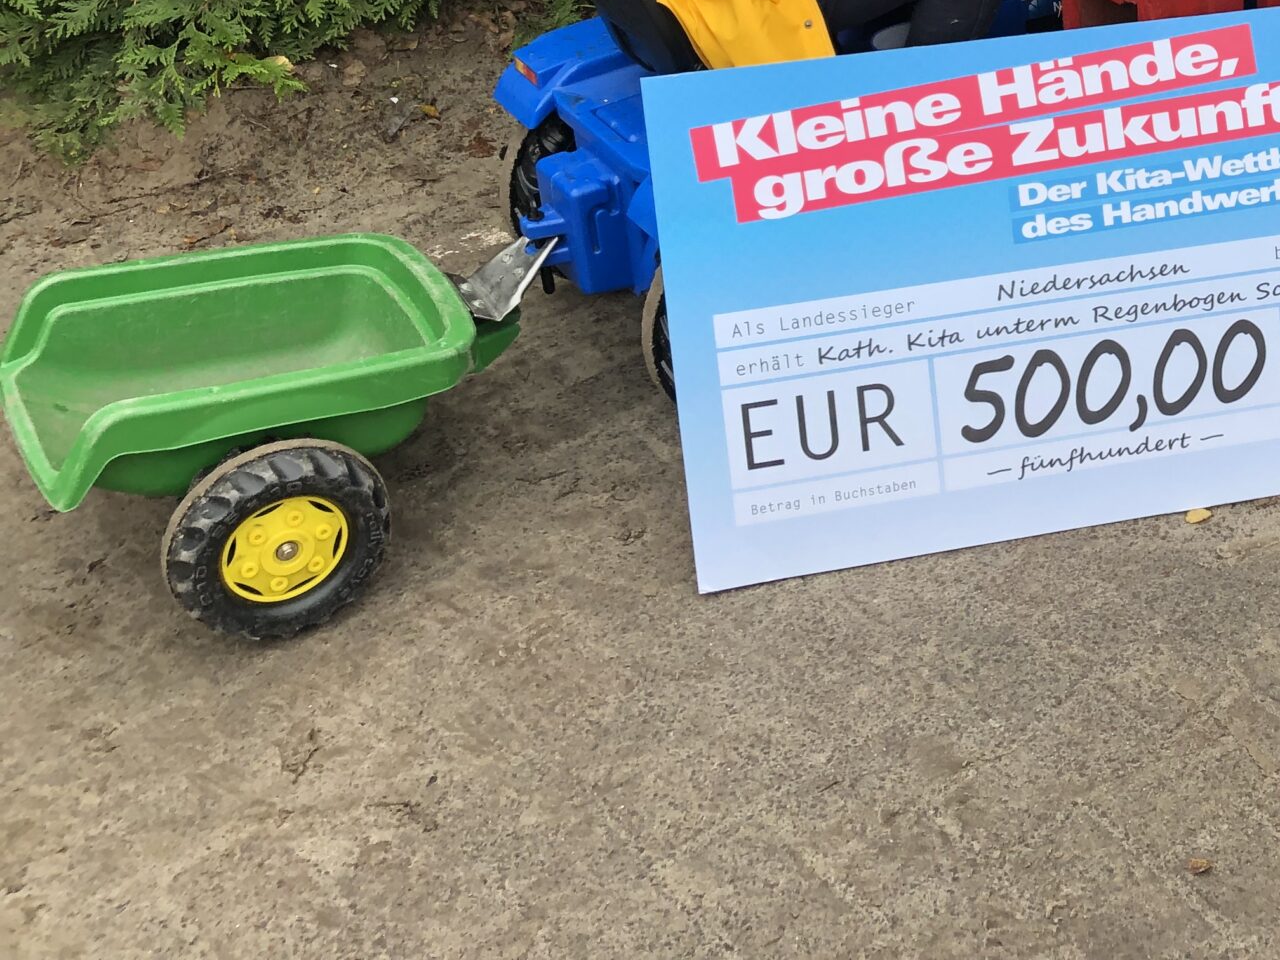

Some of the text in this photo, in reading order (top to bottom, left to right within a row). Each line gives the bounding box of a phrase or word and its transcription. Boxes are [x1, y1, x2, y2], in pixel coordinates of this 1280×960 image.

[711, 37, 1239, 168] Kleine Hände,
[750, 137, 993, 220] große
[1017, 180, 1087, 207] Der
[1020, 212, 1093, 239] des
[731, 320, 765, 338] Als
[778, 300, 915, 331] Landessieger
[996, 262, 1190, 301] Niedersachsen
[735, 352, 804, 377] erhält
[817, 337, 893, 365] Kath.
[906, 328, 964, 352] Kita
[975, 315, 1080, 340] unterm
[1091, 290, 1247, 323] Regenbogen
[739, 317, 1267, 471] EUR 500,00
[749, 498, 801, 516] Betrag
[809, 493, 826, 506] in
[833, 479, 917, 502] Buchstaben
[1017, 431, 1191, 481] fünfhundert
